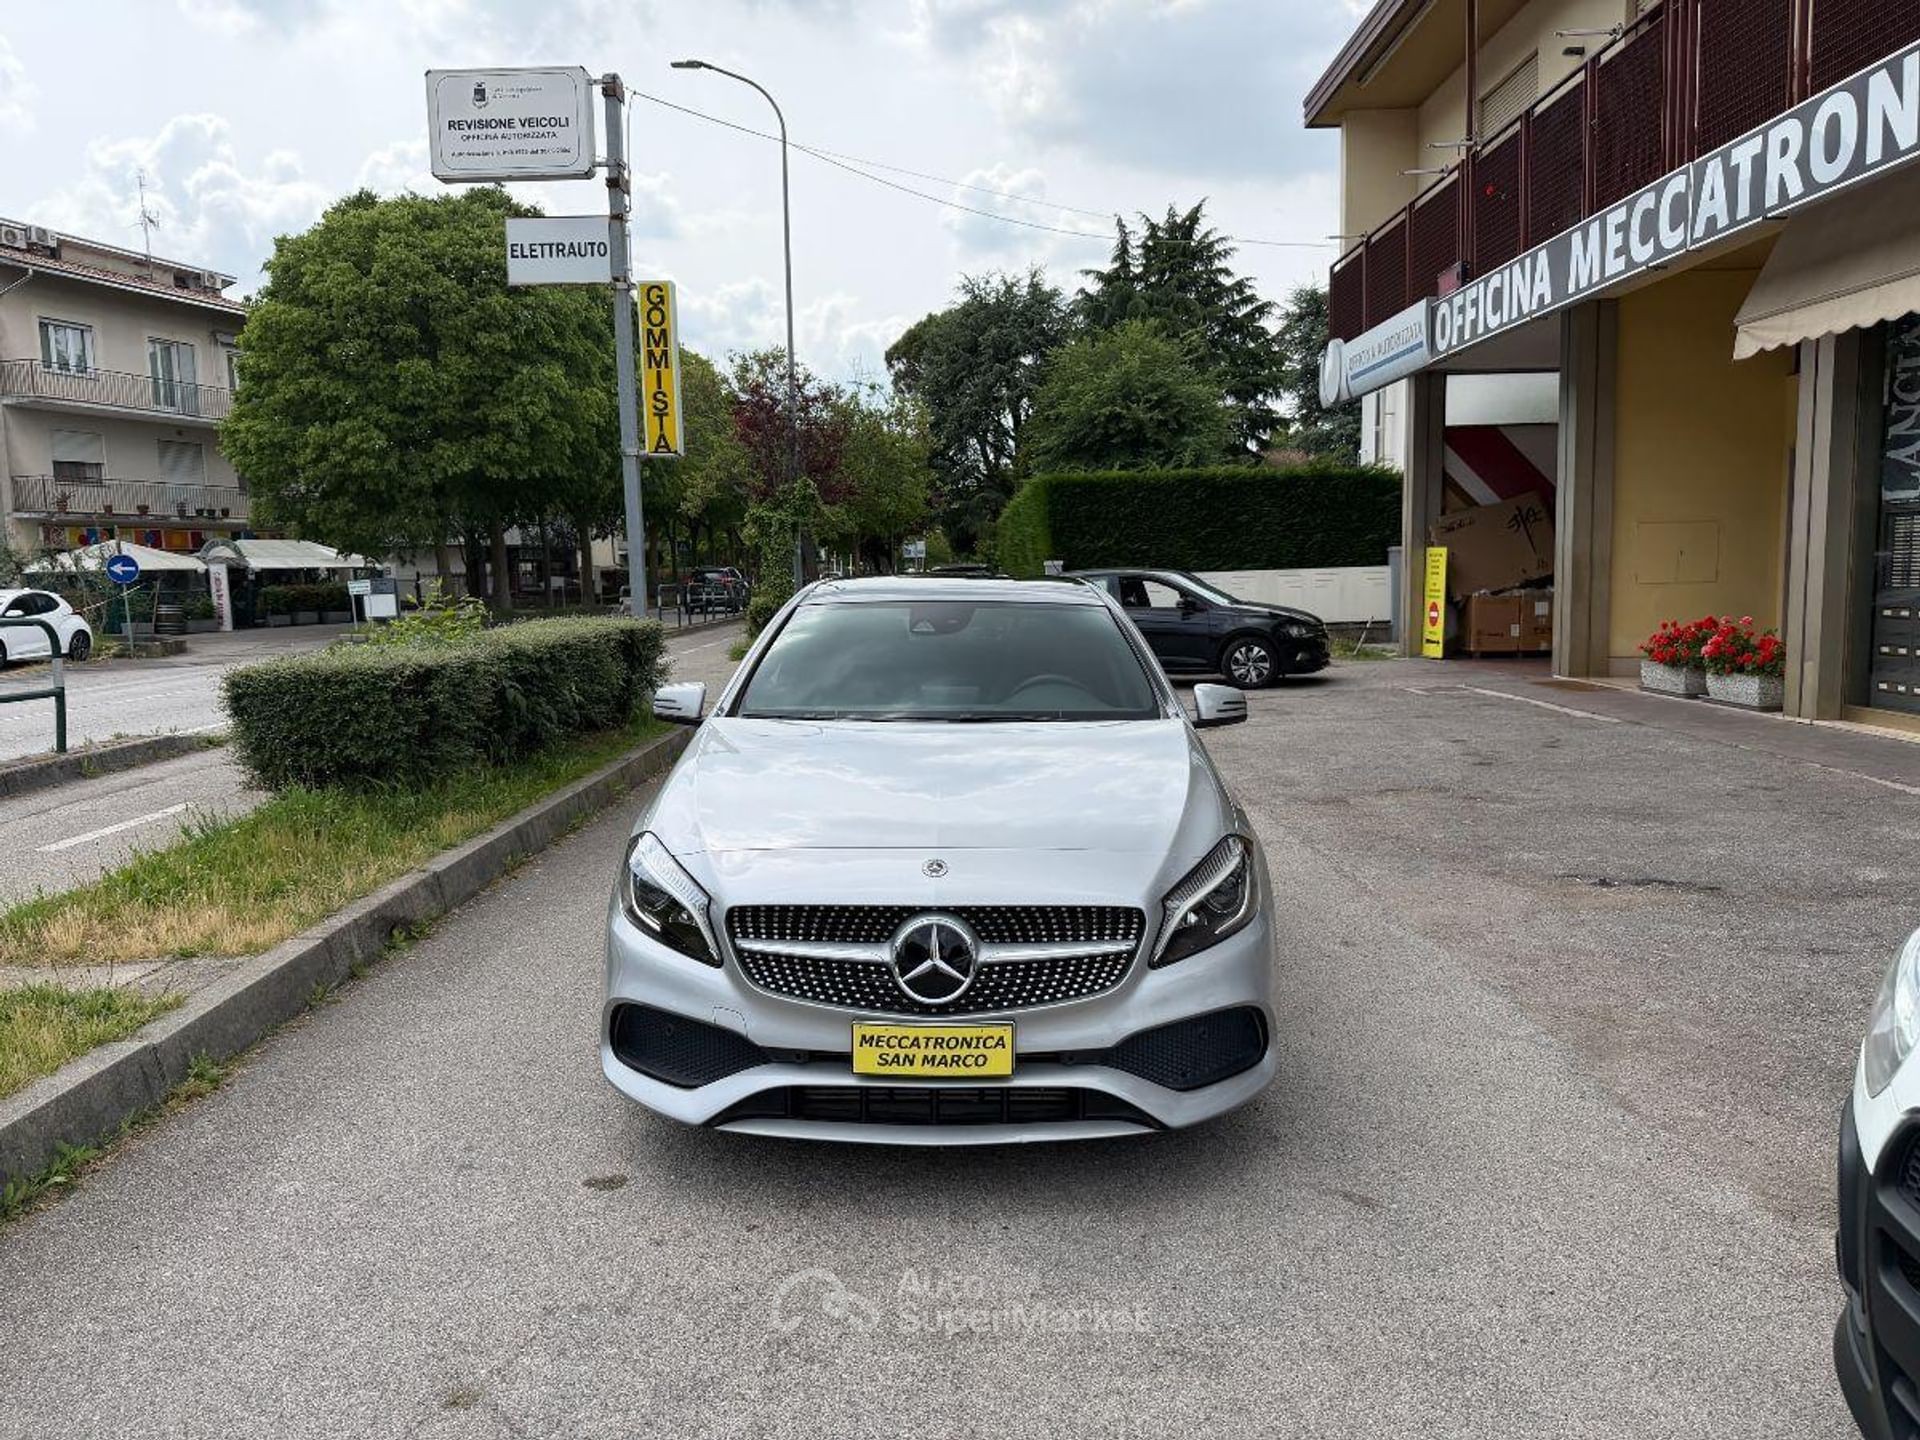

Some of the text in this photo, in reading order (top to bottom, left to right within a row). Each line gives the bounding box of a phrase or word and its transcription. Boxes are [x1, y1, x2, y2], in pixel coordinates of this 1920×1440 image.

[448, 116, 569, 131] REVISIONE VEICOLI
[1434, 50, 1920, 353] OFFICINA MECCATRON
[510, 241, 608, 259] ELETTRAUTO
[646, 285, 672, 454] GOMMISTA
[859, 1034, 1006, 1050] MECCATRONICA
[877, 1053, 988, 1068] SAN MARCO
